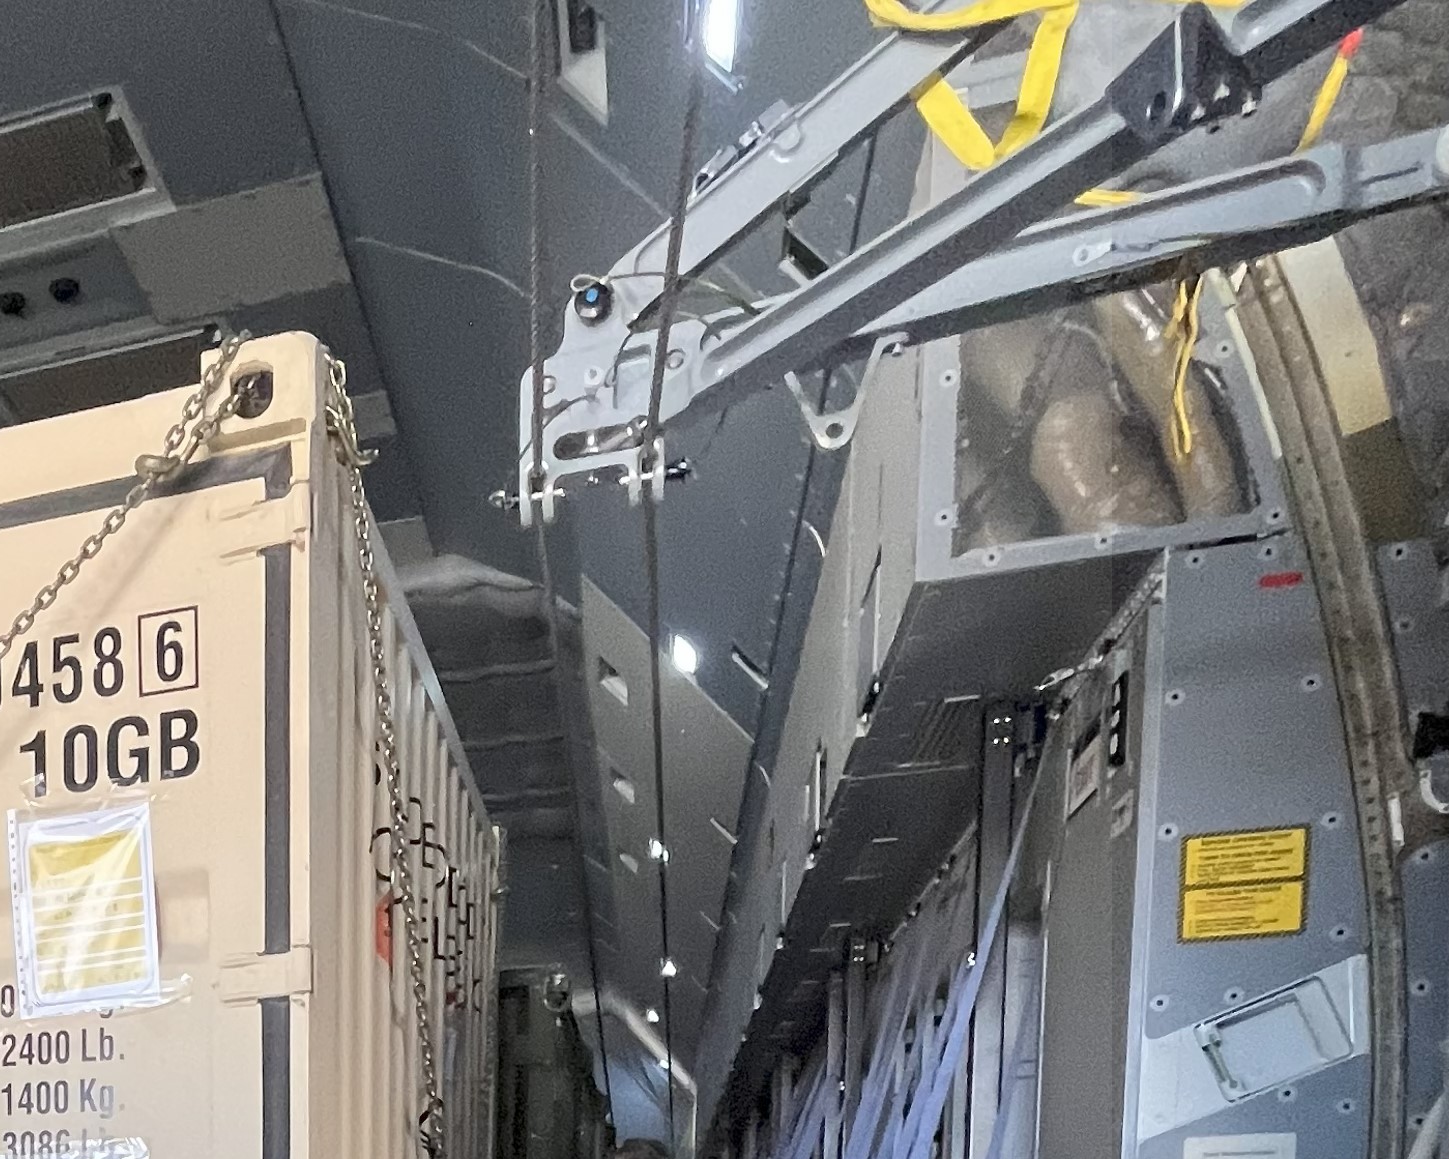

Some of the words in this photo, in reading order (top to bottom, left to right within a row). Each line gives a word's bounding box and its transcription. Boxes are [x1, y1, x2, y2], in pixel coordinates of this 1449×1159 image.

[156, 621, 184, 682] 6
[19, 709, 201, 798] 10GB
[81, 1027, 126, 1062] Lb.
[1, 1080, 69, 1116] 1400
